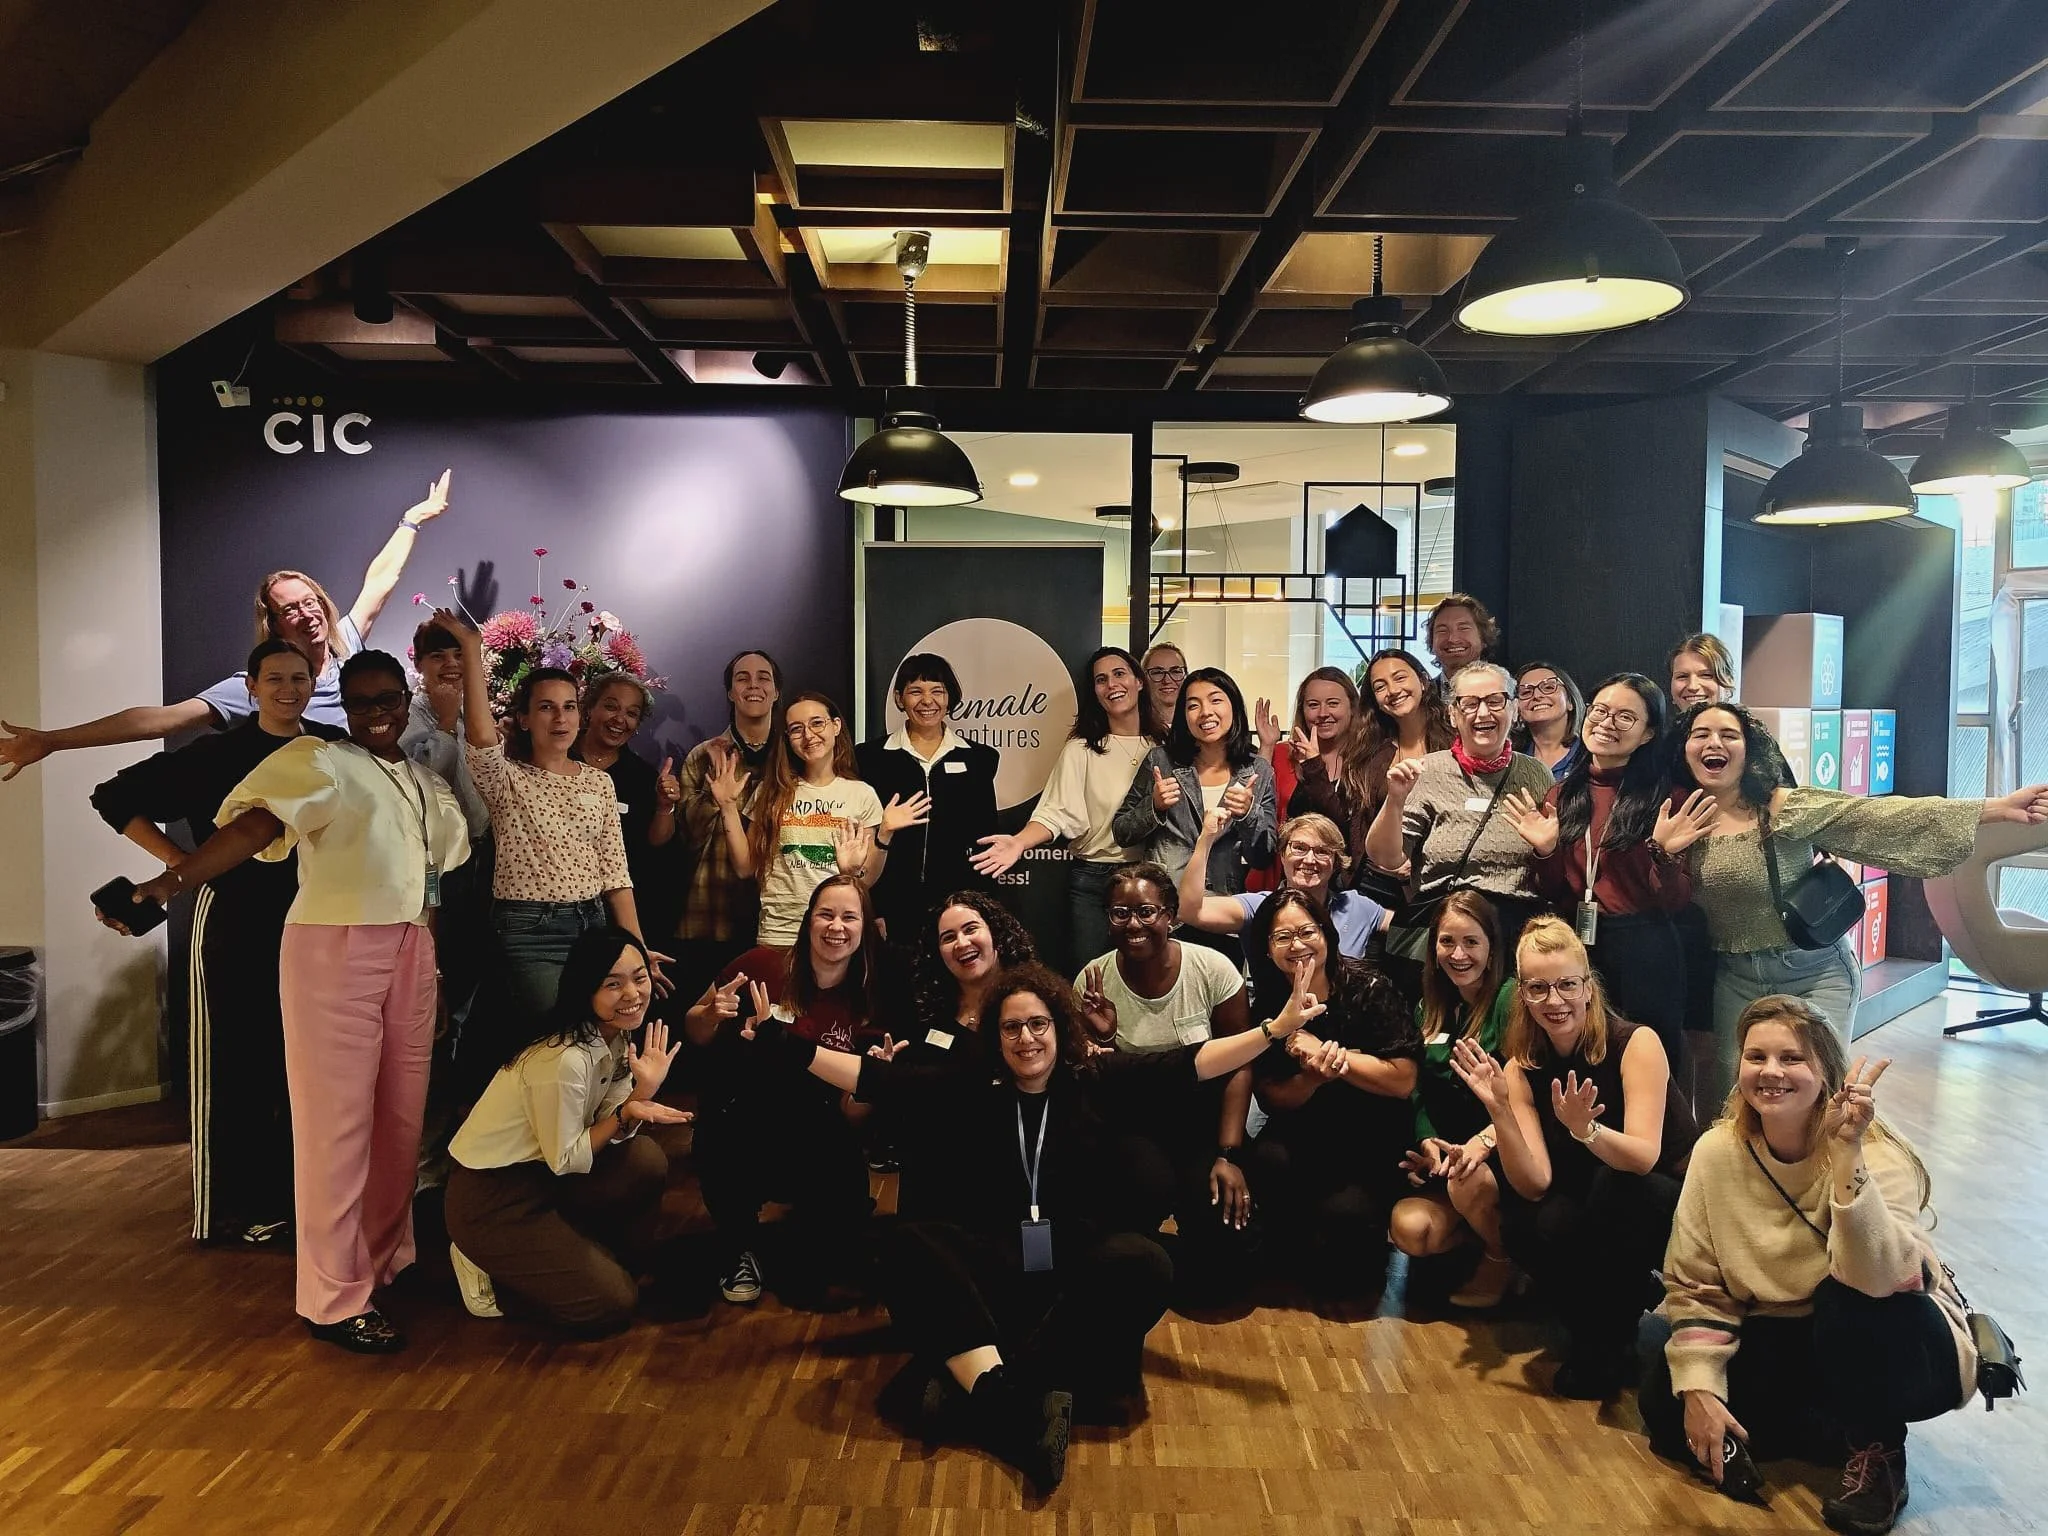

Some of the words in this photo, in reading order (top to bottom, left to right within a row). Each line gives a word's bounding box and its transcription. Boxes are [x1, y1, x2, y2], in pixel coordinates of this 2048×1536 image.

[263, 411, 373, 455] CIC
[947, 683, 1048, 721] emale
[788, 799, 813, 816] ARD
[1022, 847, 1074, 861] omen
[997, 870, 1030, 885] ess!
